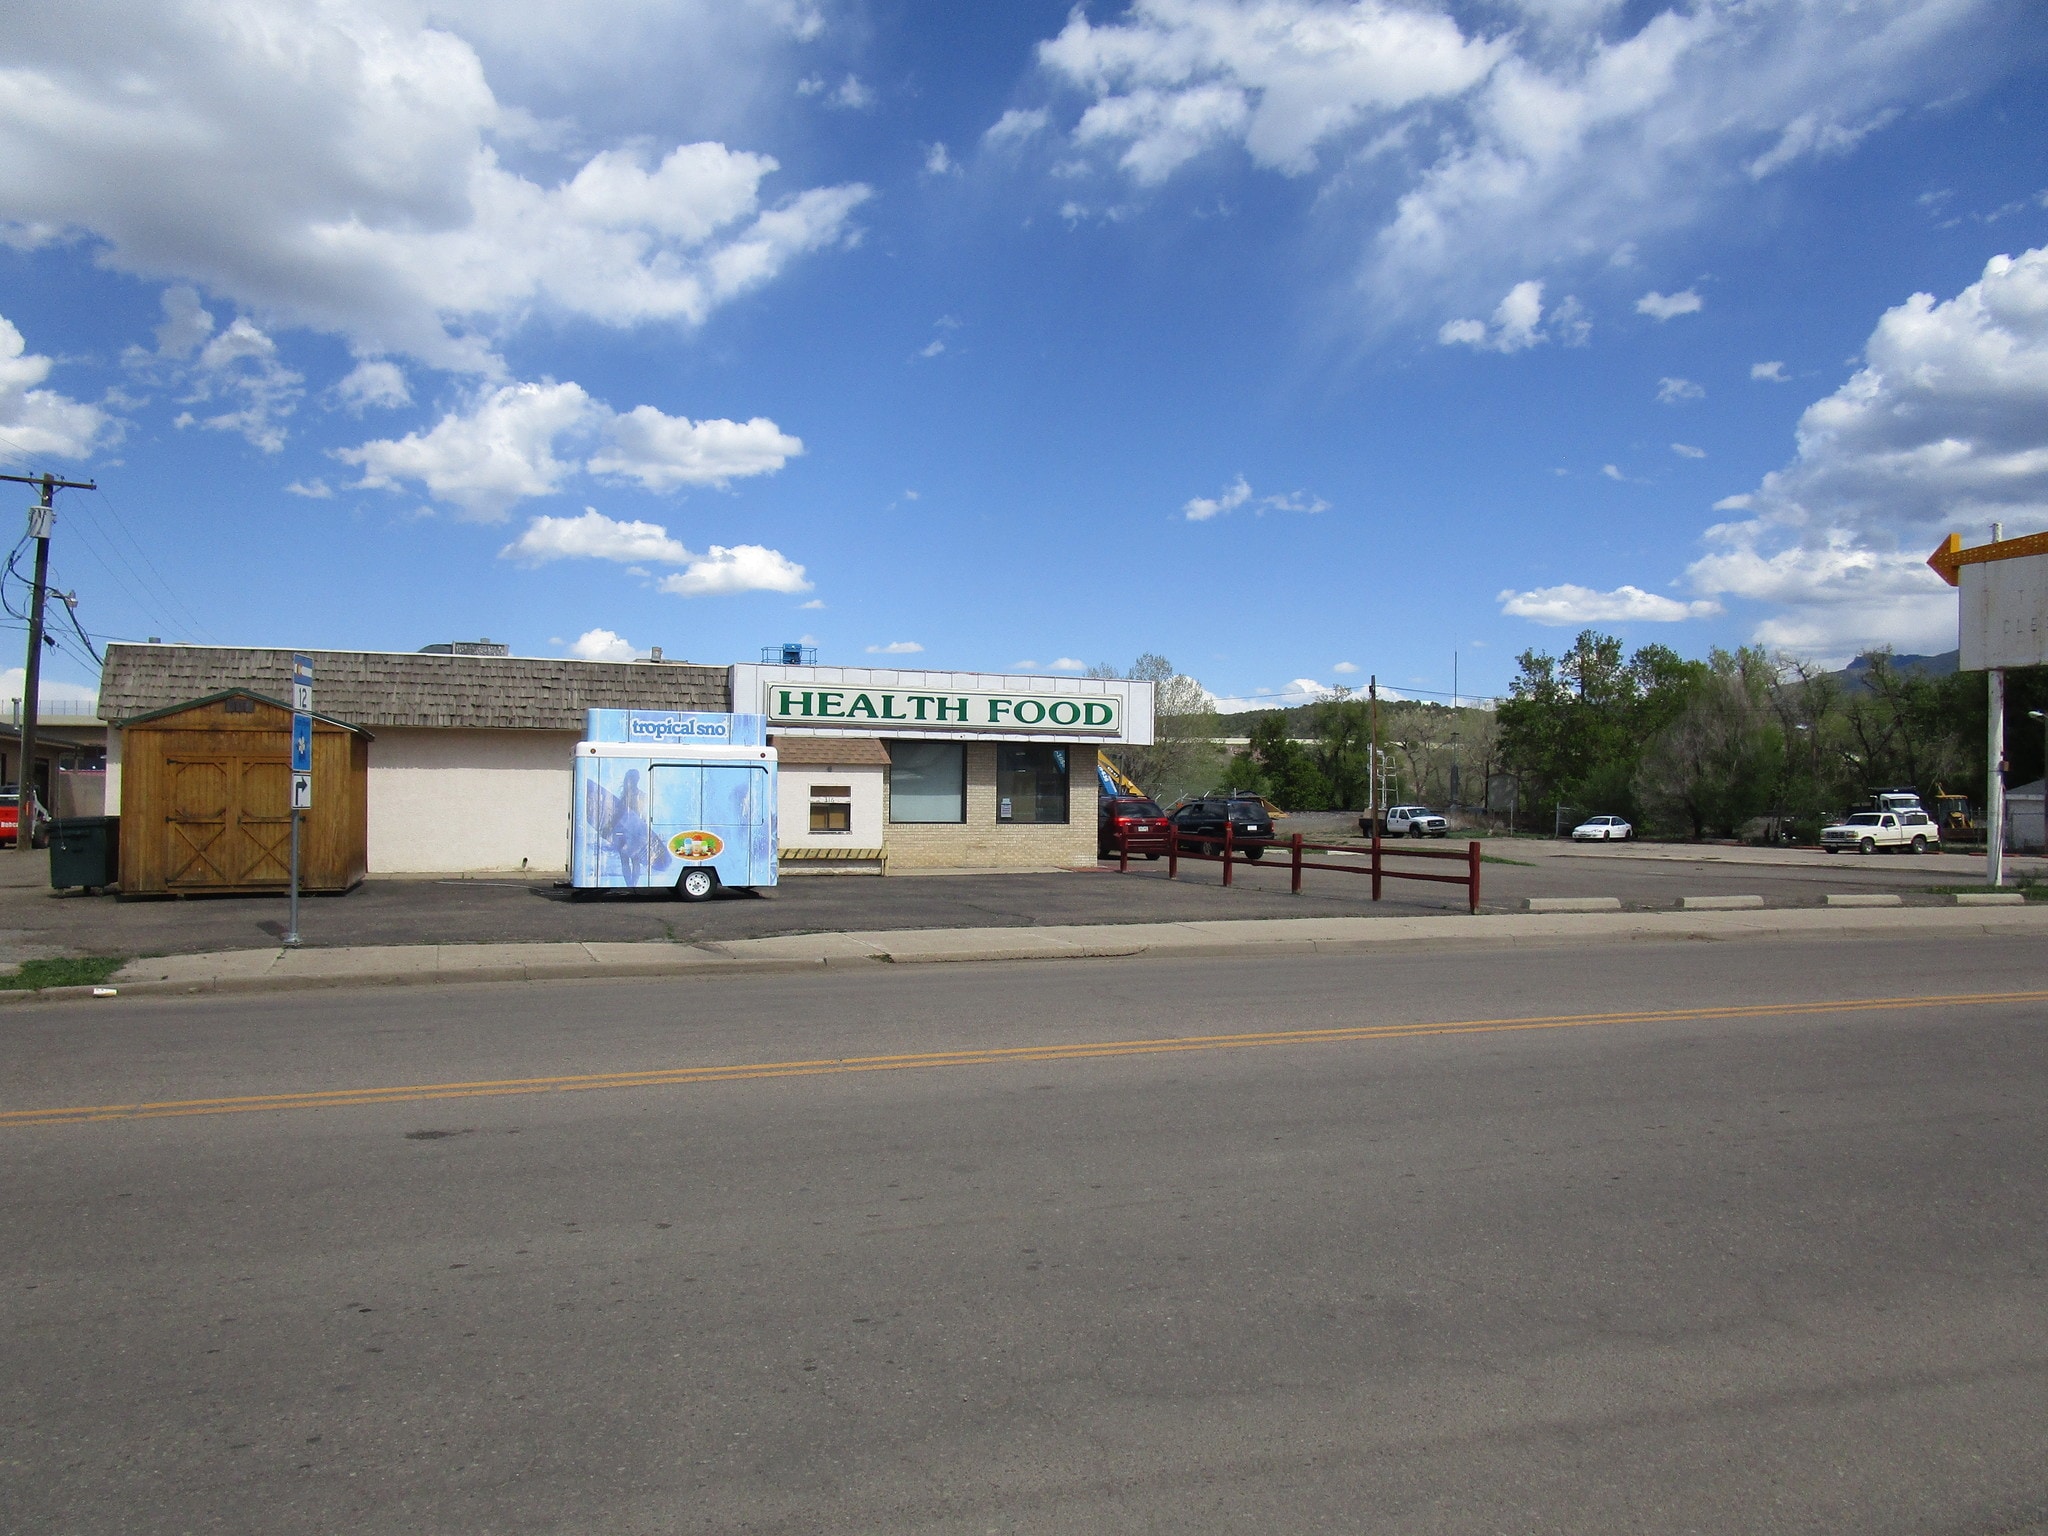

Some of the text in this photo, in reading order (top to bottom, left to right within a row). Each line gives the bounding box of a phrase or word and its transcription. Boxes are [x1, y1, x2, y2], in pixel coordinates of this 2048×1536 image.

[299, 687, 307, 708] 12
[778, 690, 1113, 726] HEALTH FOOD
[632, 719, 726, 738] tropical sno
